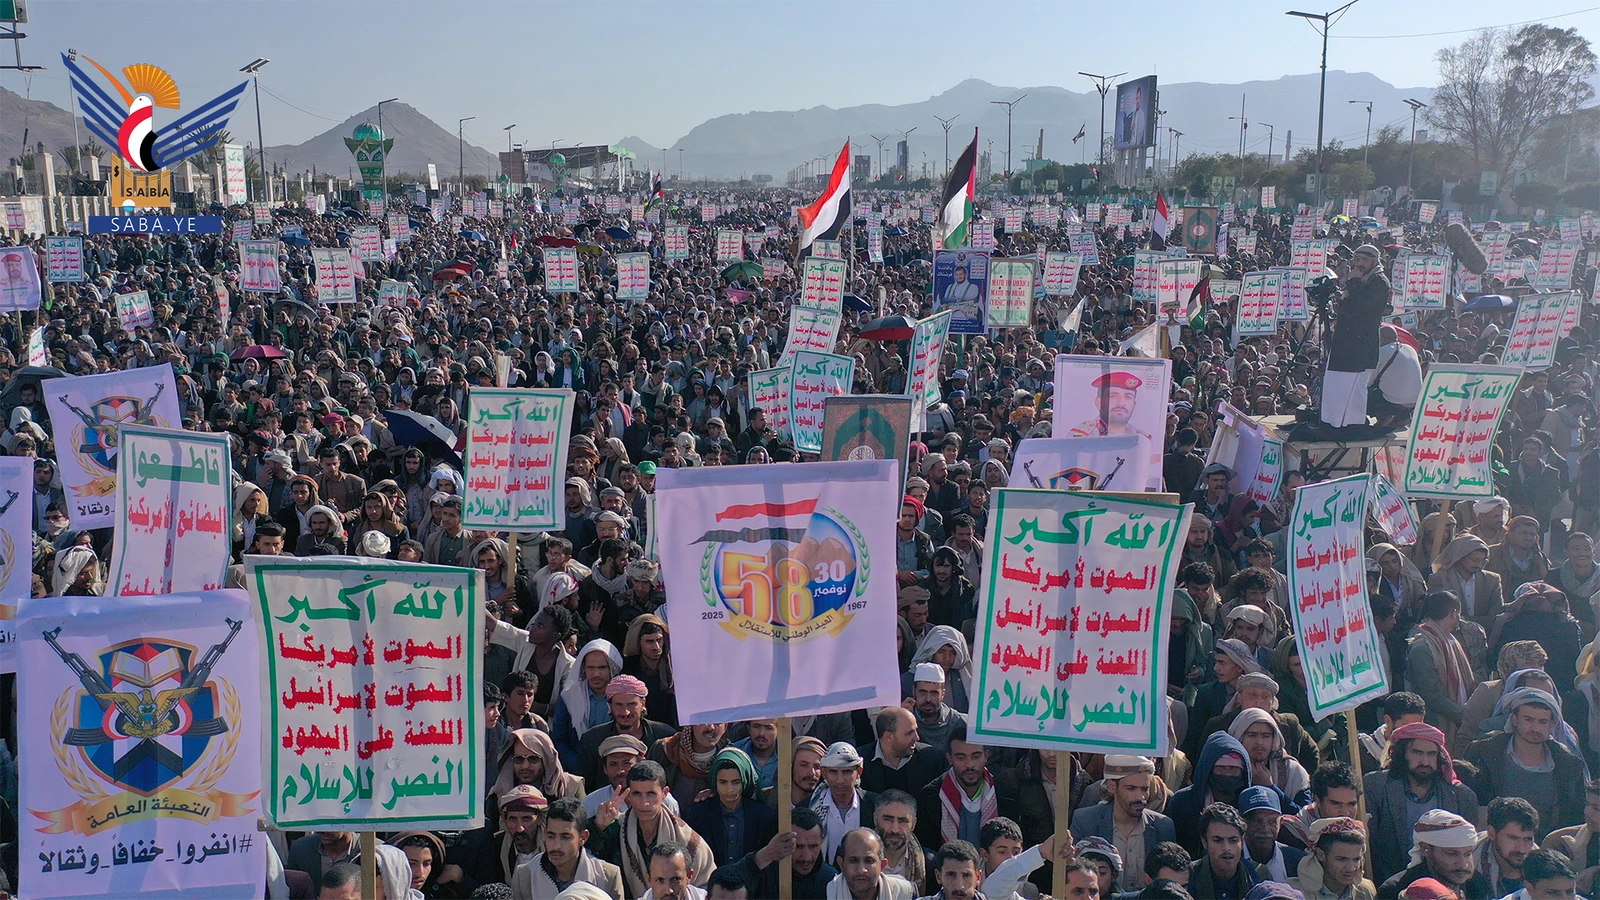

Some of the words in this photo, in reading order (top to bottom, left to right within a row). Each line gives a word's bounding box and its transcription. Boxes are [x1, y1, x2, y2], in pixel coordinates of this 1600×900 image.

[796, 357, 830, 378] أكبر
[830, 361, 848, 379] الله
[1430, 378, 1484, 403] أكبر
[1480, 380, 1511, 398] الله
[472, 397, 526, 427] أكبر
[526, 401, 557, 421] الله
[795, 413, 815, 427] اليهود
[1424, 404, 1470, 422] لأمريكا
[472, 429, 516, 446] لأمريكا
[520, 432, 554, 446] الموت
[1418, 425, 1465, 446] لإسرائيل
[132, 441, 220, 488] قاطعوا
[470, 452, 514, 470] لإسرائيل
[519, 455, 552, 470] الموت
[1414, 448, 1446, 462] اليهود
[1468, 448, 1487, 463] اللعنة
[469, 476, 502, 492] اليهود
[504, 478, 520, 494] على
[524, 476, 550, 490] اللعنة
[1410, 466, 1452, 489] للإسلام
[1452, 468, 1490, 489] النصر
[128, 493, 174, 534] الأمريكية
[177, 499, 226, 539] البضائع
[466, 496, 511, 522] للإسلام
[514, 496, 550, 522] النصر
[1296, 485, 1342, 541] أكبر
[1341, 488, 1363, 524] الله
[1004, 502, 1107, 554] أكبر
[1105, 513, 1171, 550] الله
[164, 538, 172, 568] و
[1296, 535, 1338, 572] لأمريكا
[814, 560, 846, 584] 30
[1002, 553, 1085, 592] لأمريكا
[1090, 563, 1156, 595] الموت
[275, 573, 388, 632] أكبر
[393, 581, 464, 620] الله
[720, 551, 814, 626] 58
[813, 585, 847, 598] نوفمبر
[1299, 577, 1340, 615] لإسرائيل
[701, 611, 724, 620] 2025
[847, 601, 868, 611] 1967
[996, 597, 1081, 643] لإسرائيل
[1086, 607, 1151, 638] الموت
[1304, 617, 1331, 651] اليهود
[279, 632, 376, 669] لأمريكا
[383, 631, 463, 665] الموت
[992, 644, 1052, 674] اليهود
[1096, 648, 1147, 675] اللعنة
[1056, 649, 1089, 683] على
[1313, 650, 1344, 693] للإسلام
[282, 676, 377, 716] لإسرائيل
[385, 674, 463, 710] الموت
[986, 680, 1070, 732] للإسلام
[1073, 685, 1147, 733] النصر
[283, 724, 350, 756] اليهود
[358, 725, 395, 759] على
[405, 718, 464, 746] اللعنة
[281, 759, 375, 816] للإسلام
[382, 755, 464, 811] النصر
[87, 800, 146, 829] العامة
[152, 797, 211, 817] التعبئة
